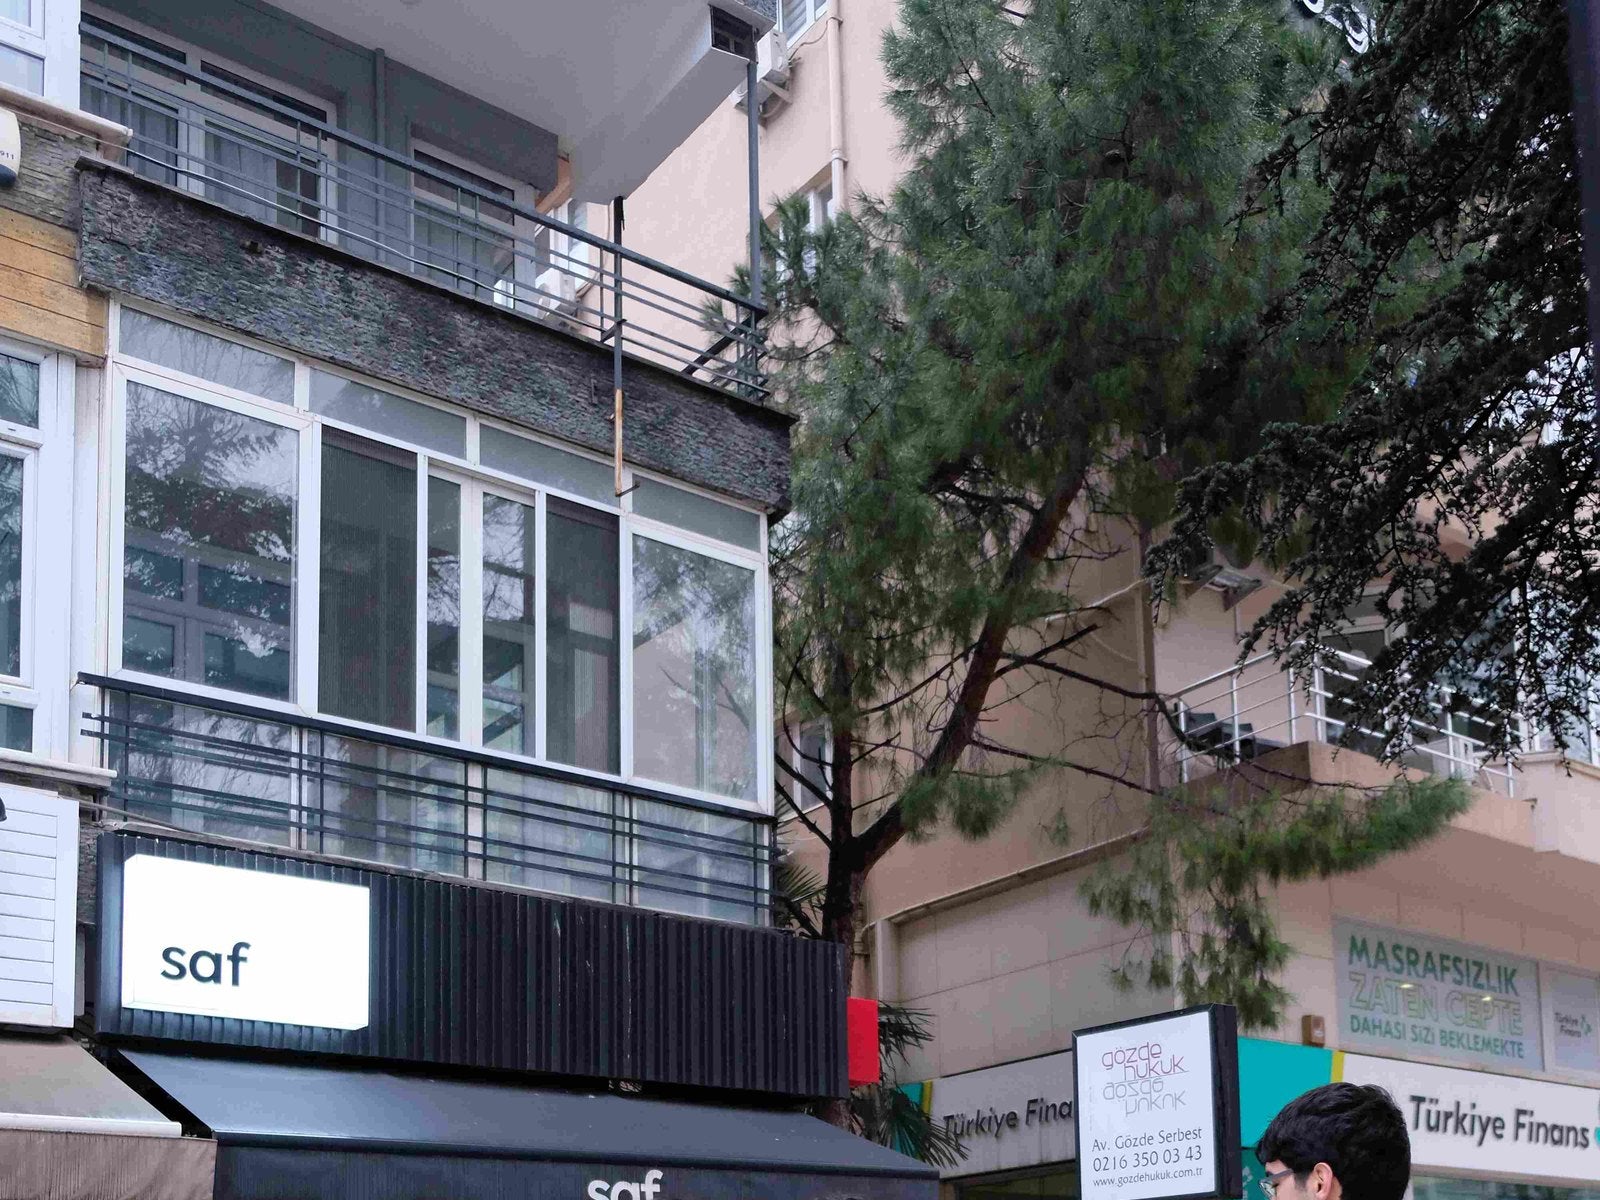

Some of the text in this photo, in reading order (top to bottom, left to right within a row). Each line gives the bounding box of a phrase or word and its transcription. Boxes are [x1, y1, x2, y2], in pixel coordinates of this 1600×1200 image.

[160, 941, 251, 987] saf
[1348, 935, 1520, 997] MASRAFSIZLIK
[1348, 971, 1524, 1037] ZATEN CEPTE
[1349, 1014, 1407, 1041] DAHASI
[1439, 1029, 1526, 1059] BEKLEMEKTE
[1101, 1041, 1162, 1070] gözde
[1124, 1054, 1185, 1080] hukuk
[943, 1107, 1019, 1138] Türkiye
[1409, 1094, 1590, 1151] Türkiye Finans
[1091, 1127, 1202, 1152] Av. Gözde Serbest
[1092, 1145, 1203, 1172] 0216 350 03 43
[1092, 1167, 1203, 1188] www.gozdehukuk.com.tr
